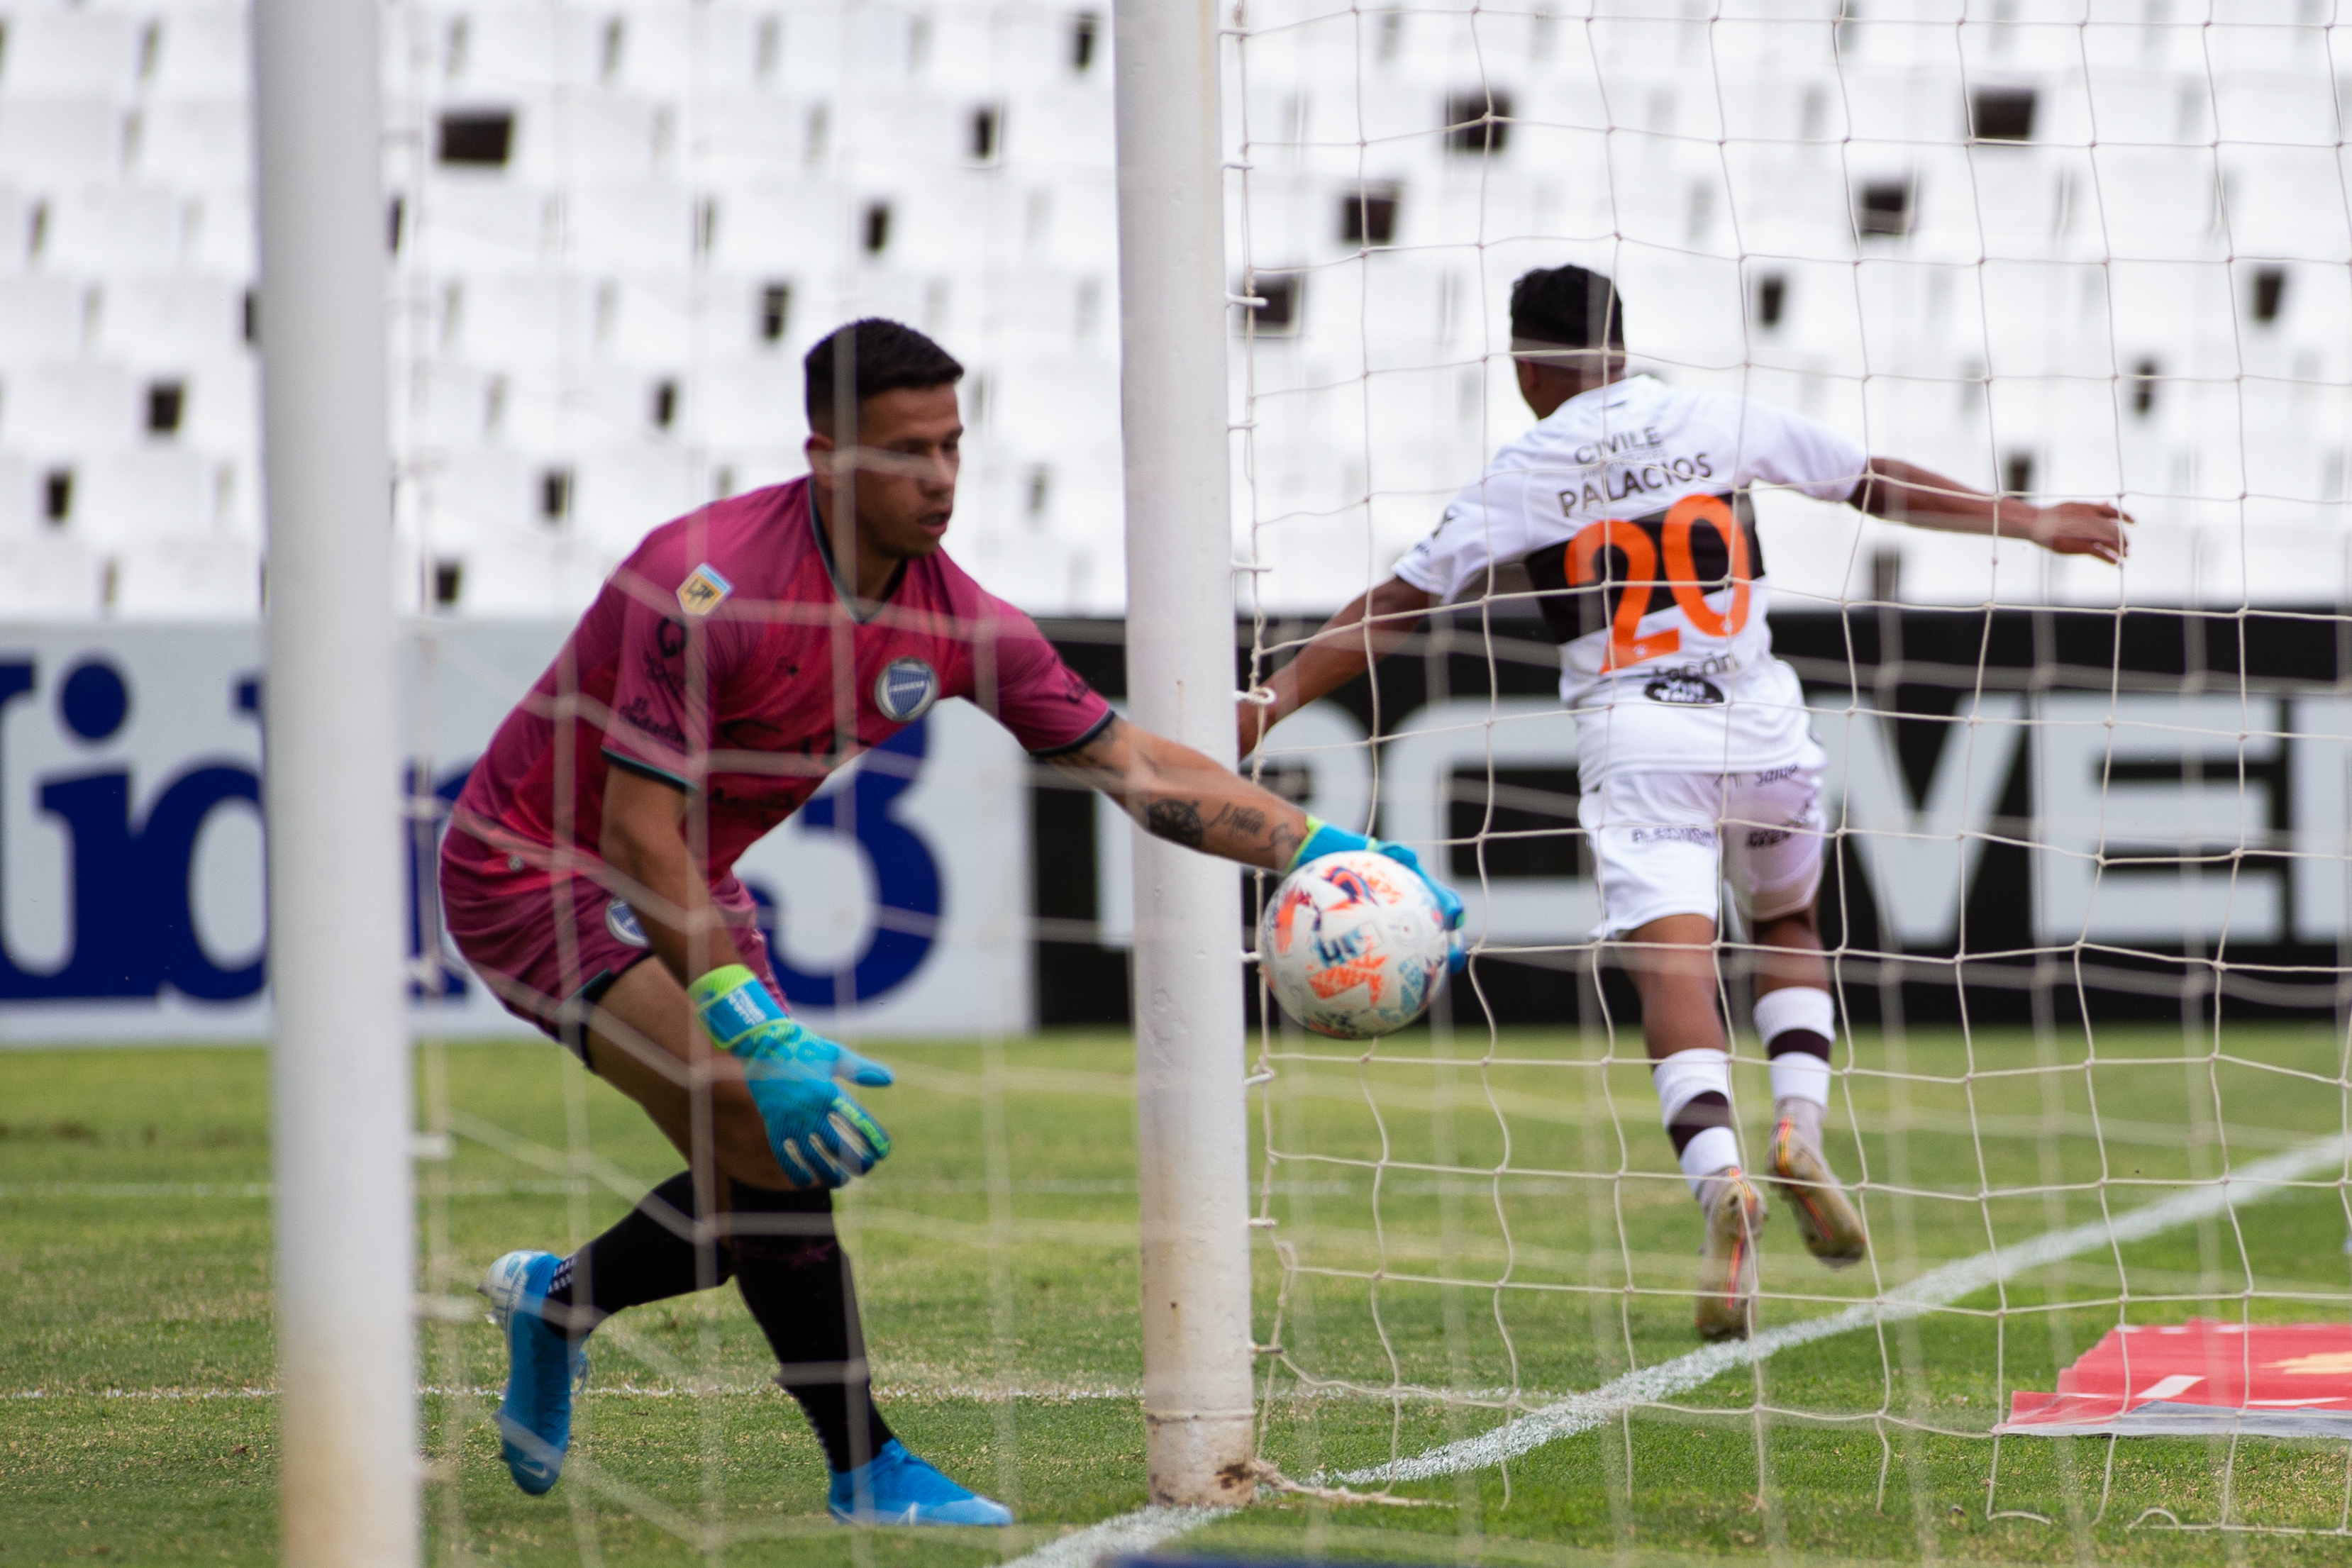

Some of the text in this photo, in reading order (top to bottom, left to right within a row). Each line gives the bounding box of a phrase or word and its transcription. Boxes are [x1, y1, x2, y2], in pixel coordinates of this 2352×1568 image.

[1574, 426, 1662, 465] CIVILE
[1558, 452, 1714, 518] PALACIOS
[1563, 493, 1752, 675] 20
